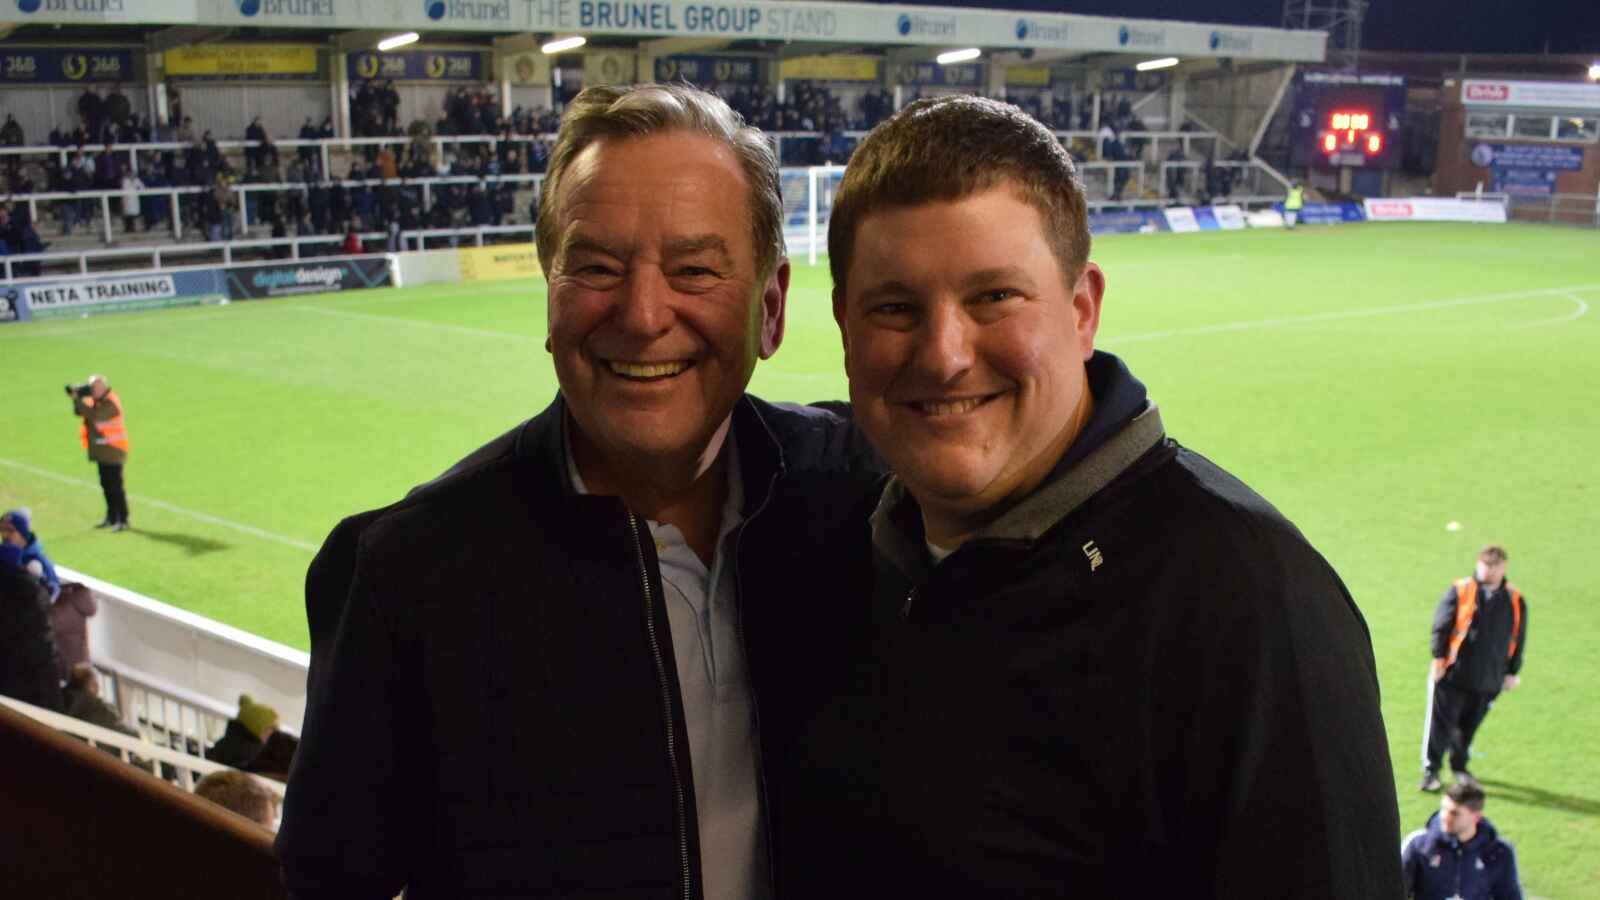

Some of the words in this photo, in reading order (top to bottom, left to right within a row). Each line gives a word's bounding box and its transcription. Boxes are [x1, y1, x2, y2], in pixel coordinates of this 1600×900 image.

[449, 0, 510, 19] Brunel
[523, 0, 571, 27] THE
[580, 1, 677, 29] BRUNEL
[684, 5, 761, 31] GROUP
[767, 8, 837, 36] STAND
[30, 286, 79, 305] NETA
[83, 279, 170, 300] TRAINING
